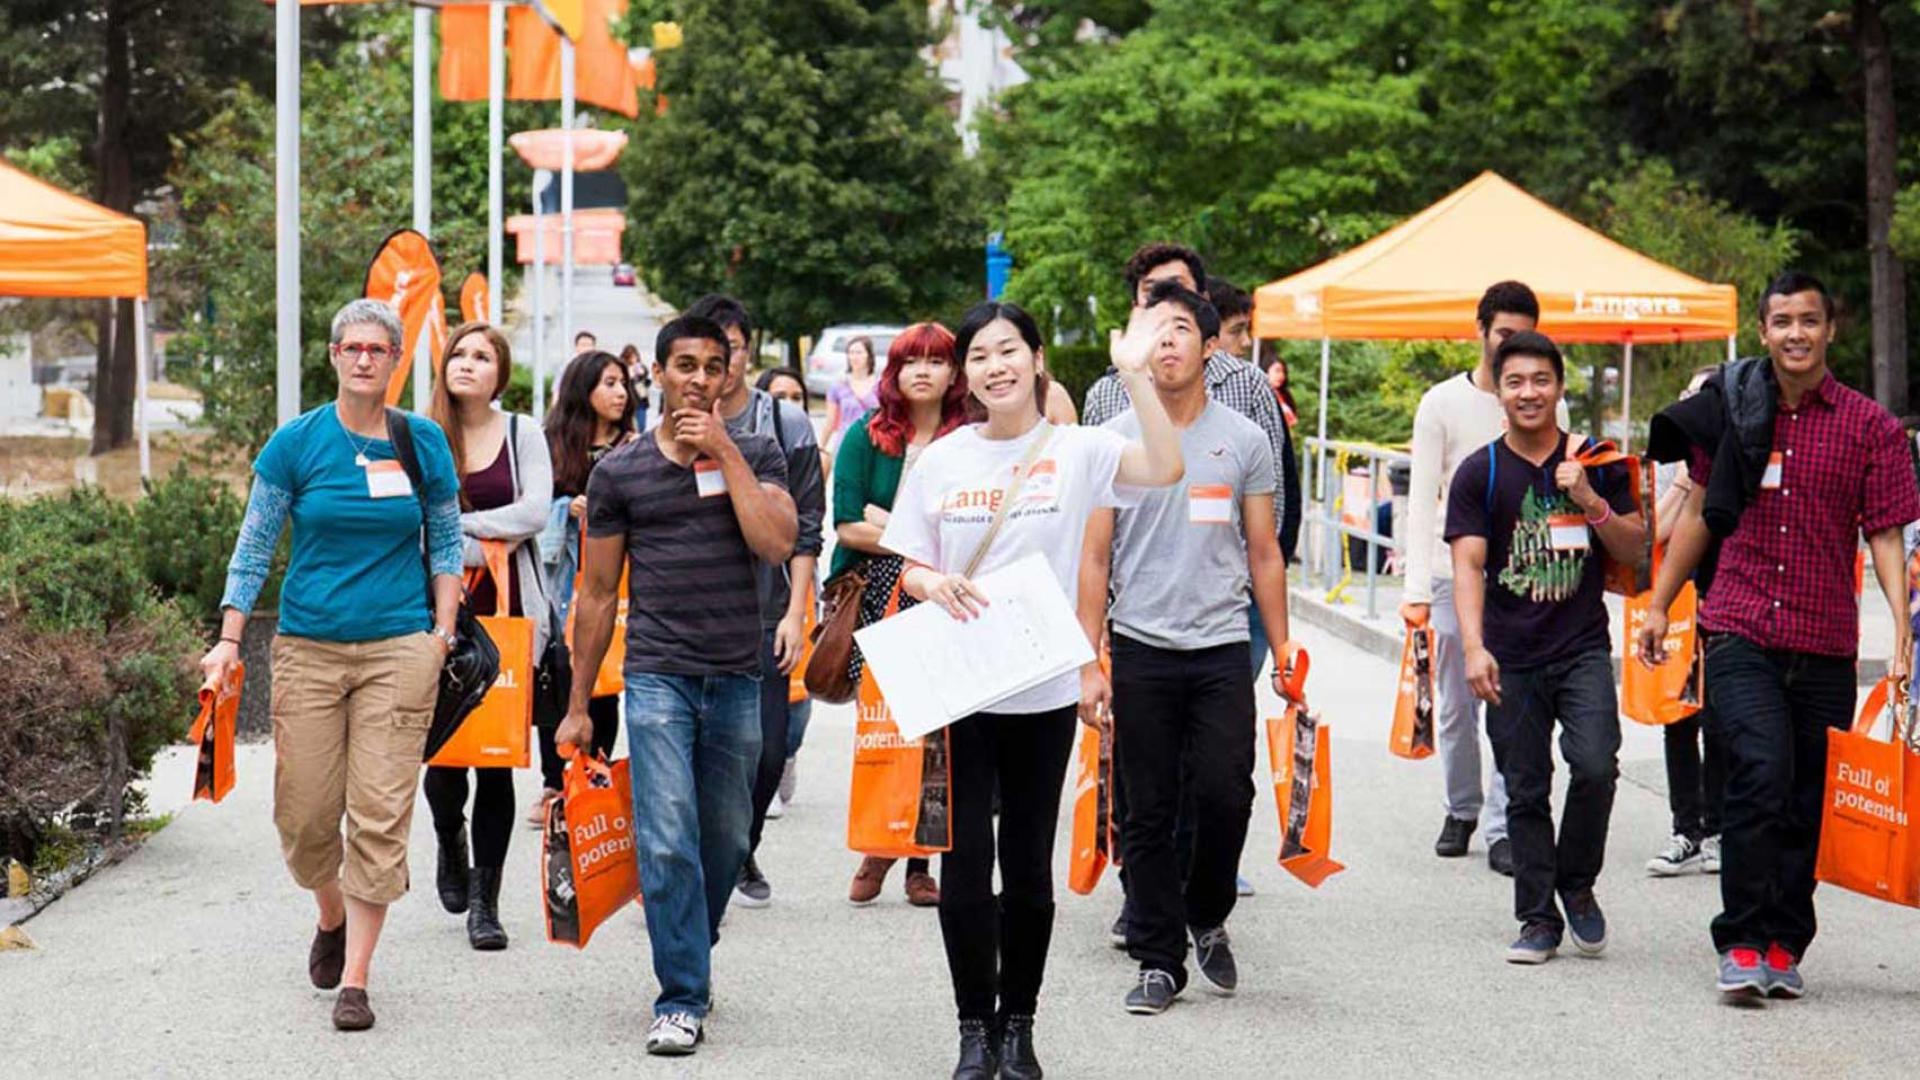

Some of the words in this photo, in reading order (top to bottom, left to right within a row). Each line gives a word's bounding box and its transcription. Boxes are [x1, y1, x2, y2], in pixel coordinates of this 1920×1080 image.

[941, 488, 1005, 513] Lang
[1837, 761, 1873, 790] Full
[574, 813, 609, 847] Full
[612, 816, 627, 832] o
